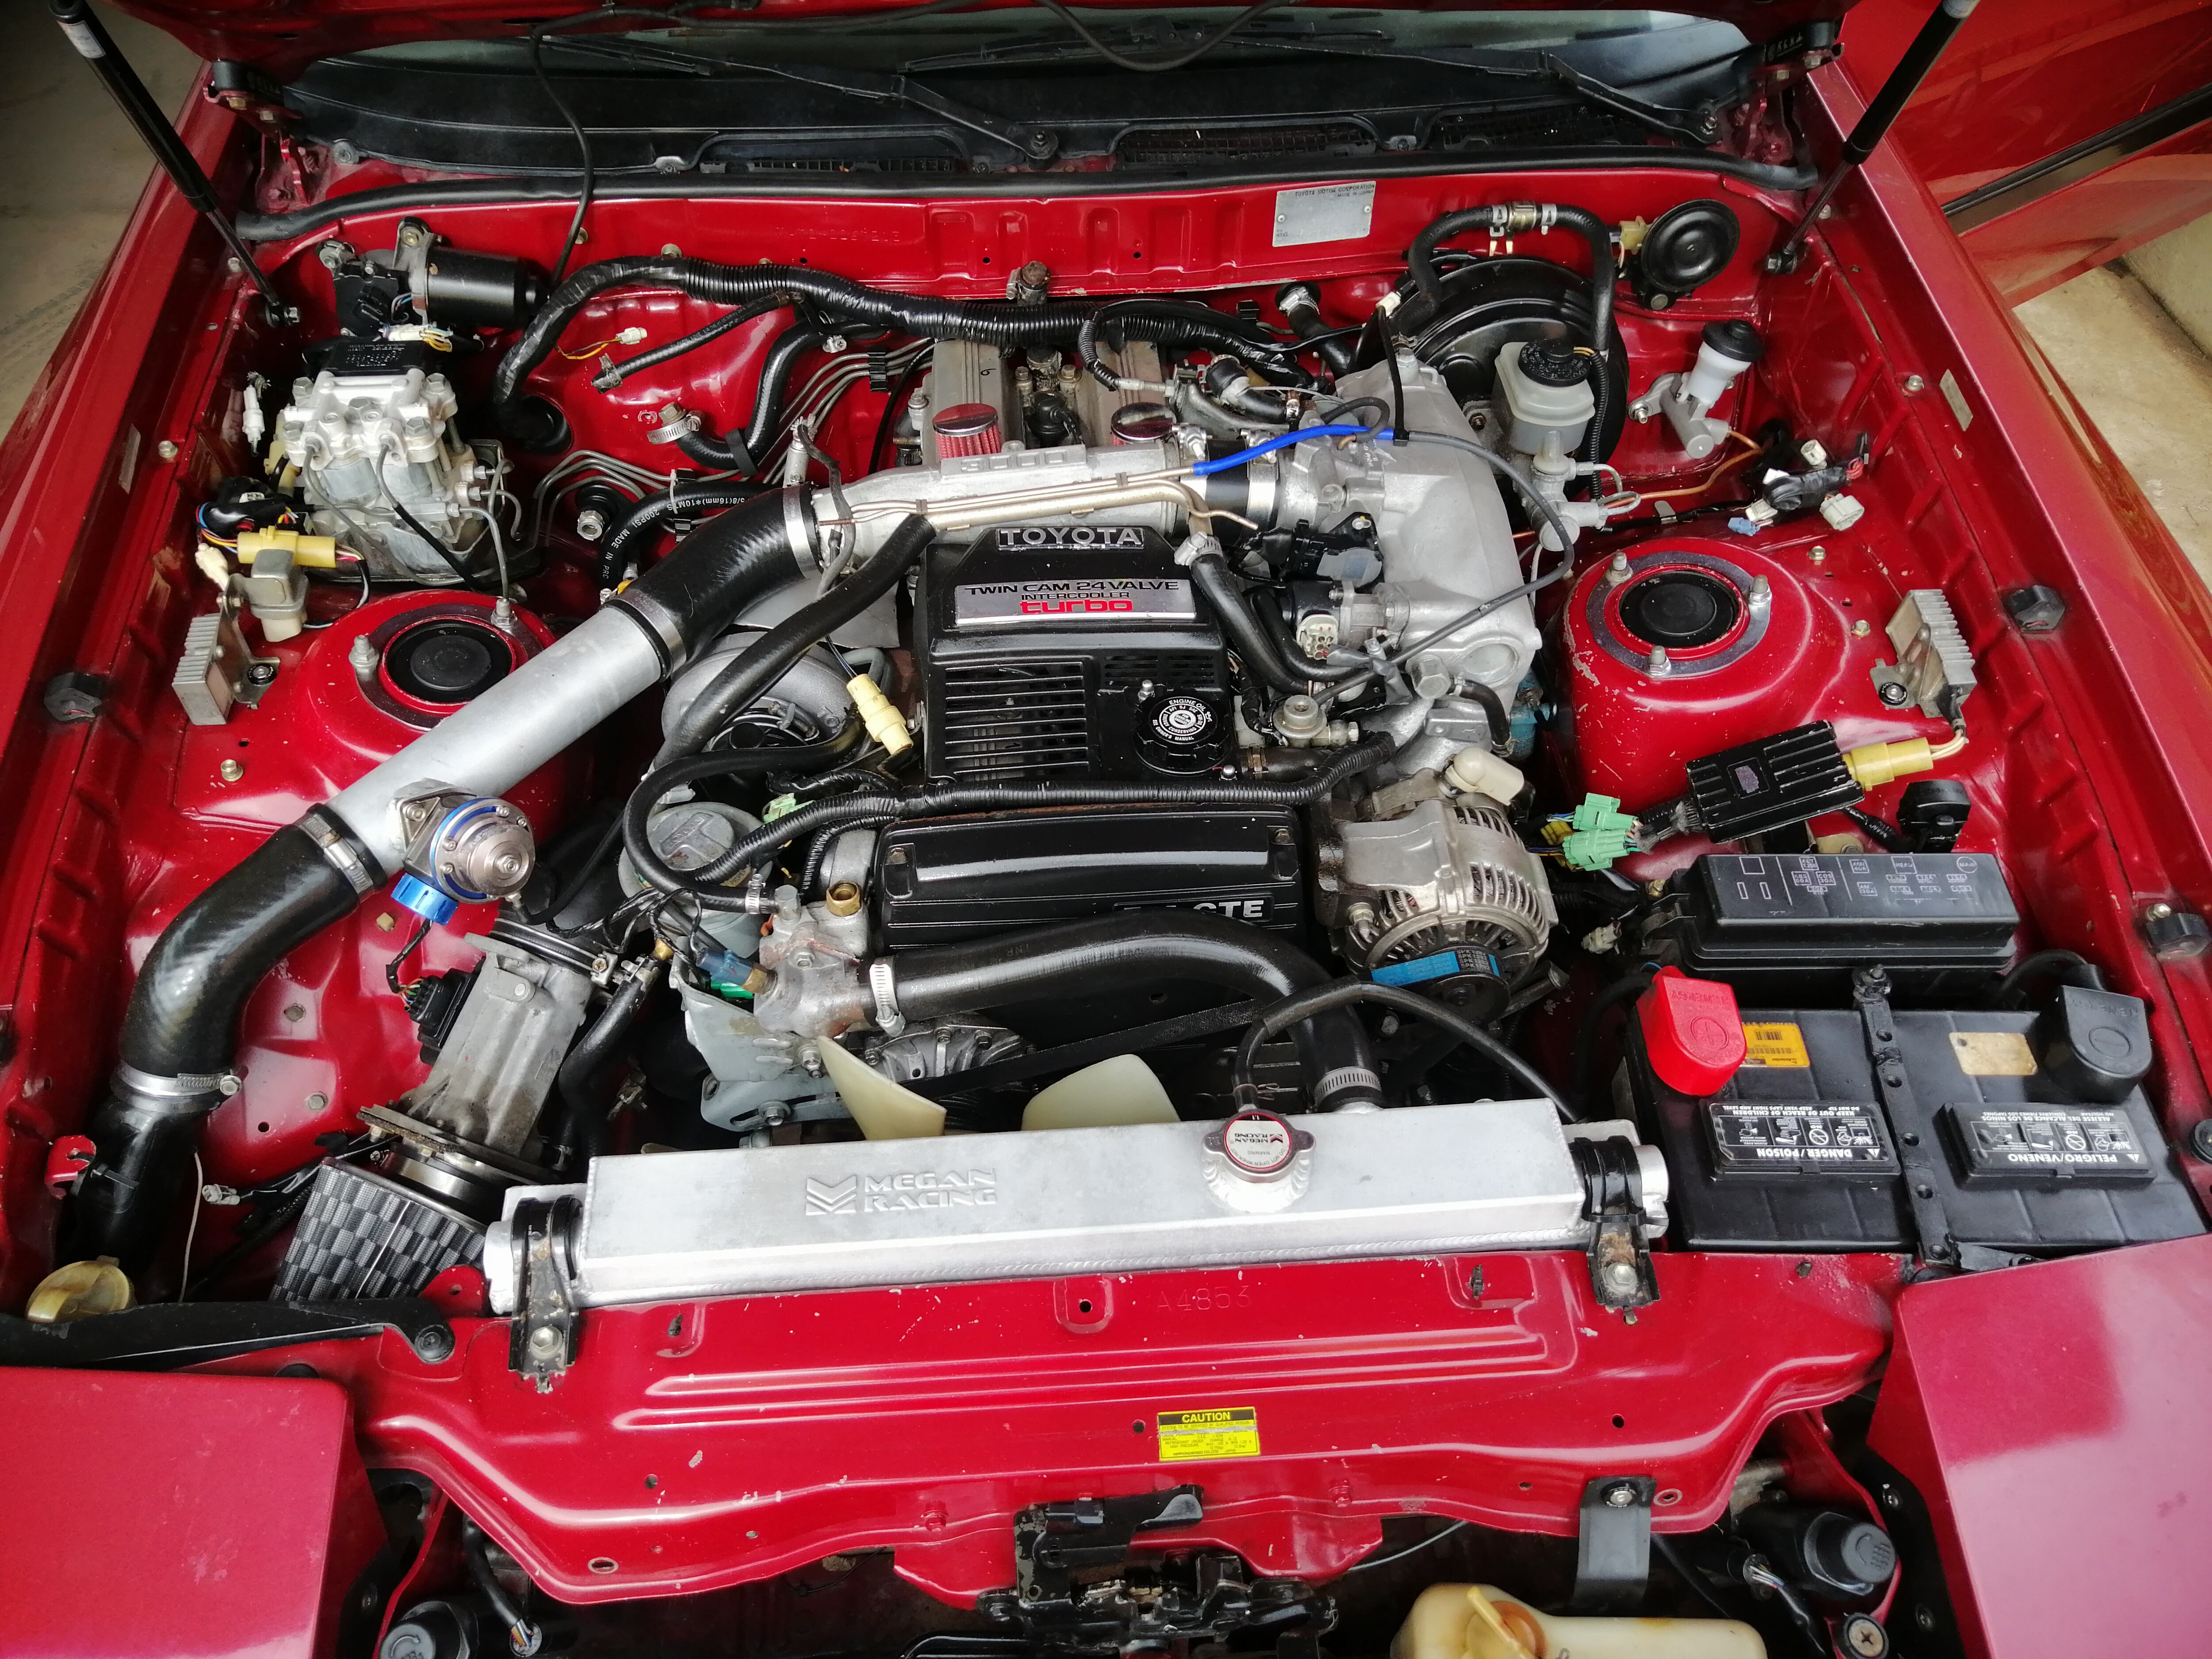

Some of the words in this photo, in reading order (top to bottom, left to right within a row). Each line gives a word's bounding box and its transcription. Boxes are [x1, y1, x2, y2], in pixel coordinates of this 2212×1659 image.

[961, 449, 1068, 472] 3000
[632, 509, 660, 528] 200PSI
[611, 529, 630, 549] MADE
[1000, 528, 1142, 545] TOYOTA
[605, 552, 614, 561] IN
[965, 585, 1018, 595] TWIN
[1023, 583, 1070, 591] CAM
[1021, 591, 1129, 600] INTERCOOLER
[1020, 599, 1133, 614] turbo
[1196, 703, 1206, 711] OIL
[1156, 726, 1172, 739] OWNER'S
[1230, 1148, 1239, 1158] HOT
[1239, 1156, 1253, 1166] WHEN
[864, 1168, 996, 1192] MEGAN
[864, 1187, 997, 1212] RACING
[1156, 1285, 1250, 1312] A4853
[1182, 1411, 1231, 1423] CAUTION
